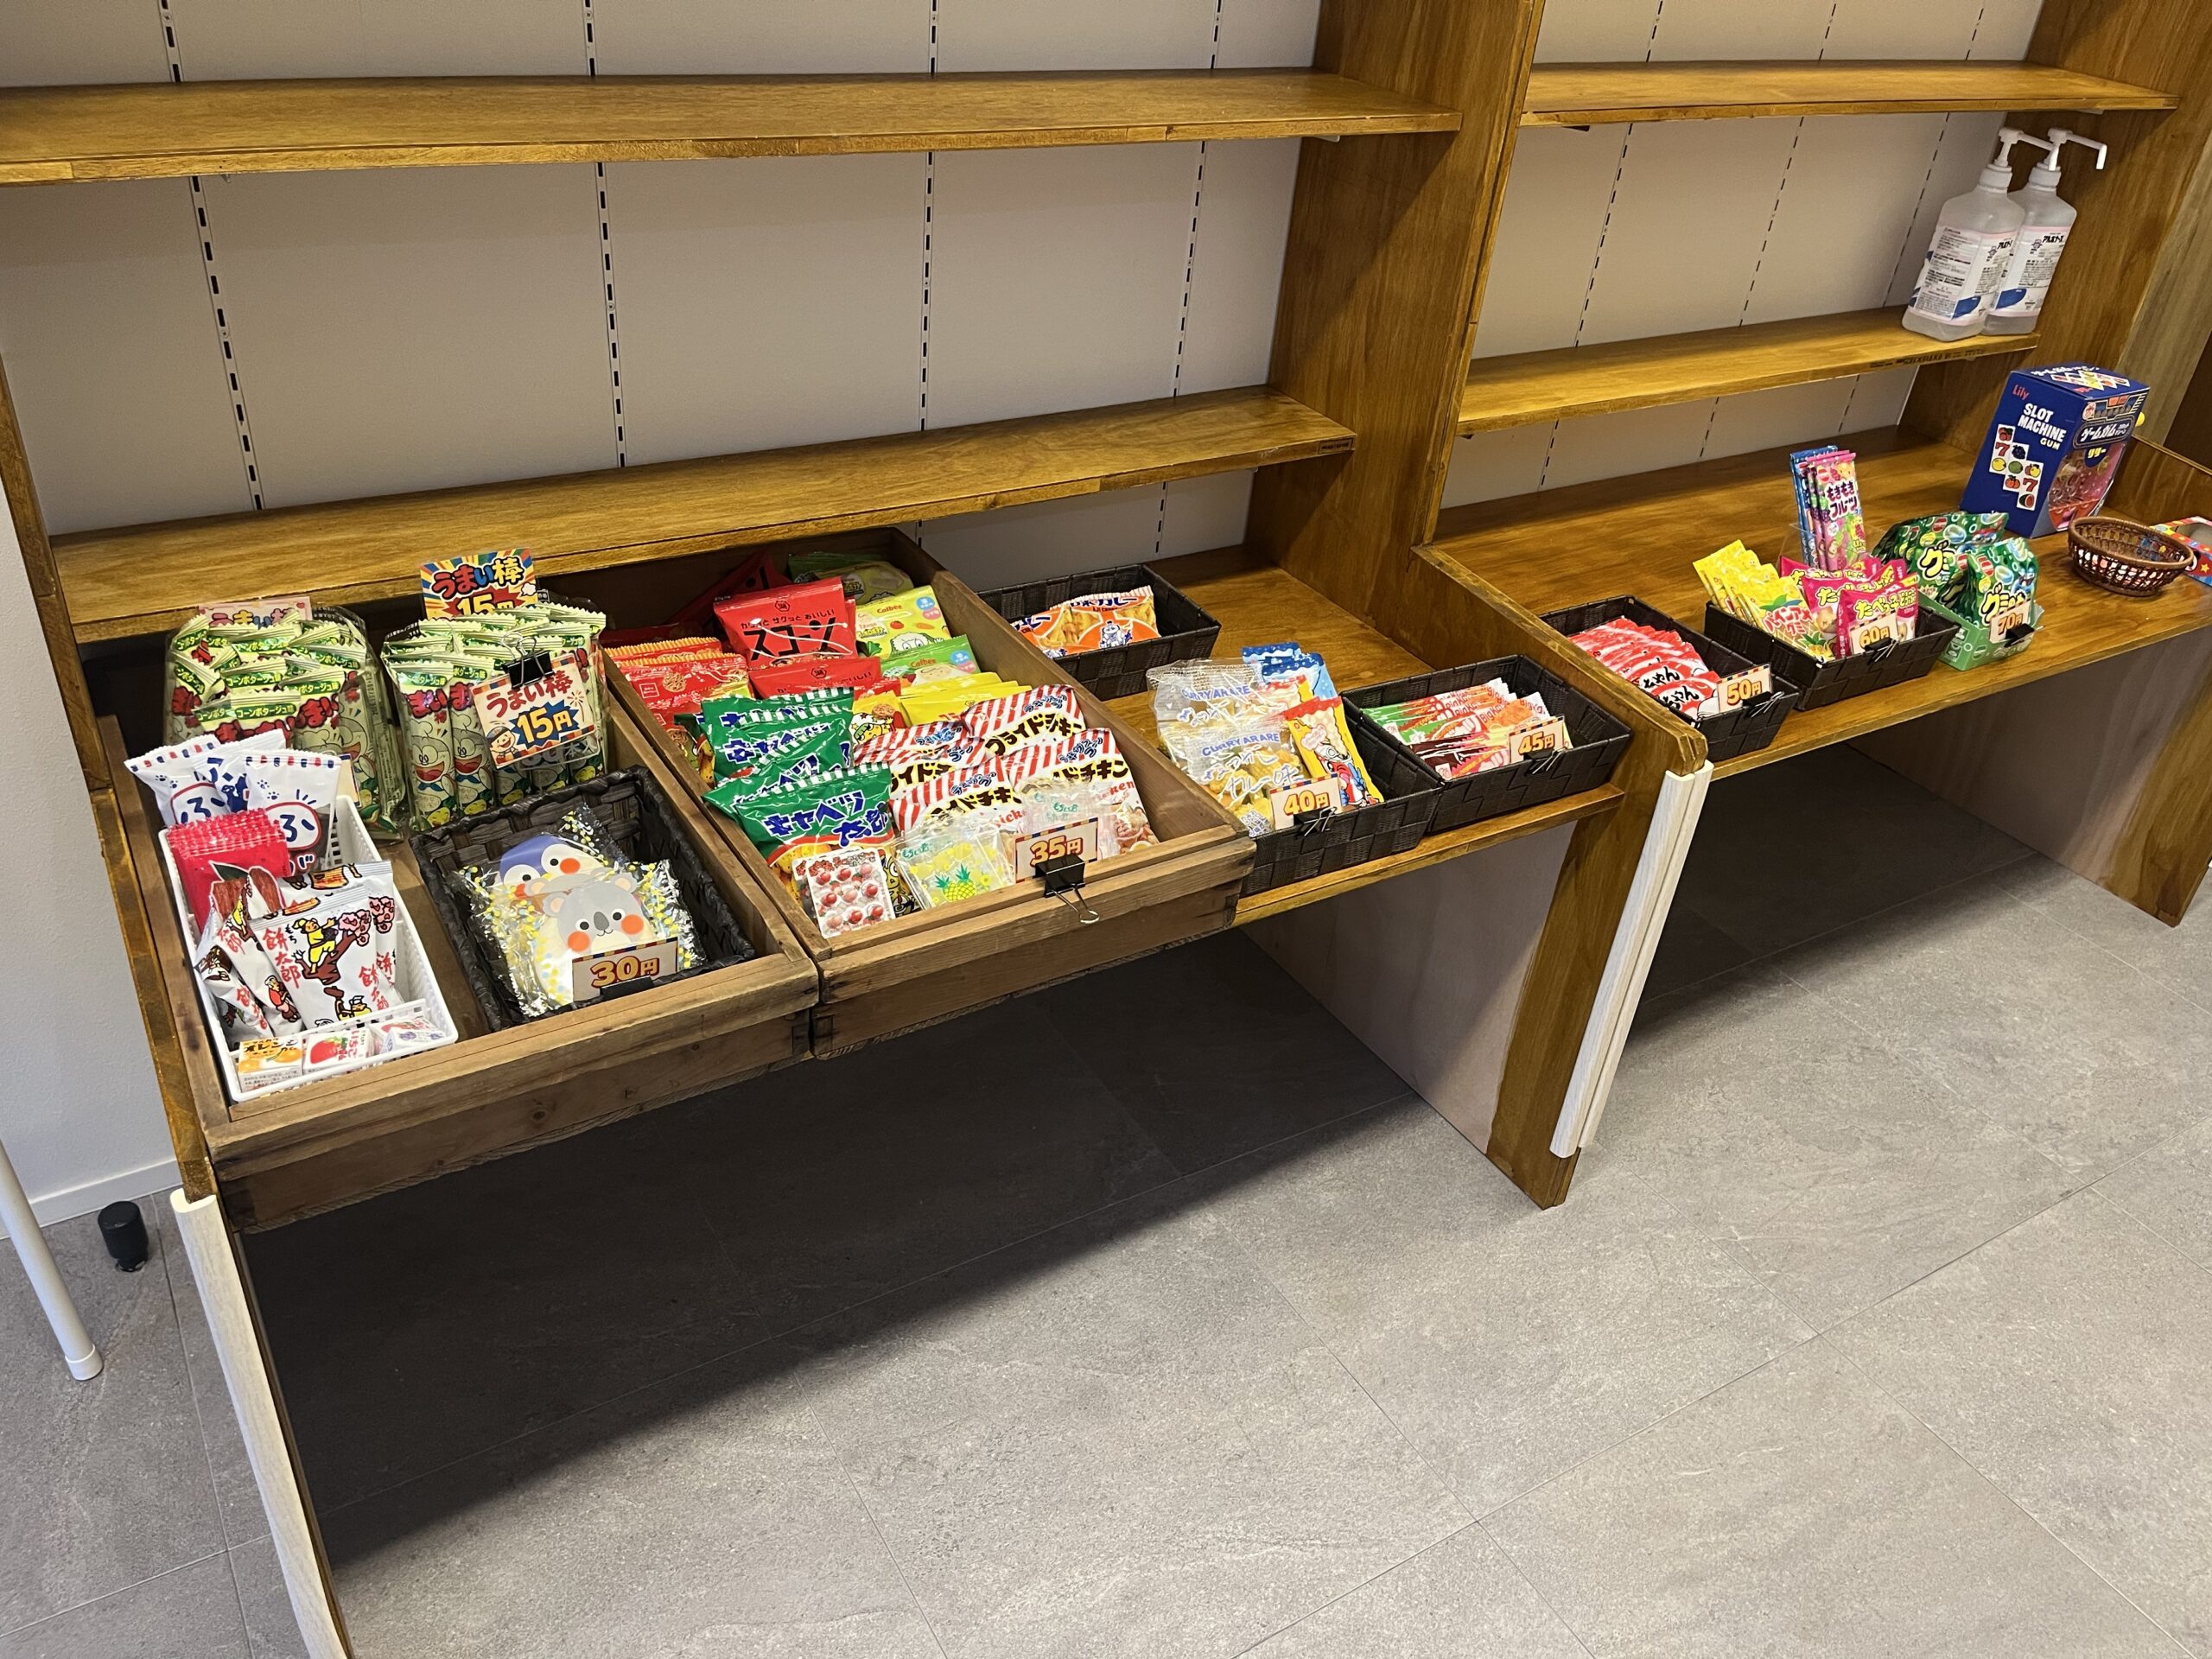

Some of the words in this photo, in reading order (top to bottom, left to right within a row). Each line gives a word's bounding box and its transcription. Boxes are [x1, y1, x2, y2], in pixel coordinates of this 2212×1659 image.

[2012, 384, 2030, 400] Lily
[2023, 403, 2054, 422] SLOT
[2017, 414, 2068, 442] MACHINE
[2039, 437, 2061, 450] GUM
[432, 556, 524, 599] うまい棒
[804, 609, 836, 620] おいしい
[876, 604, 904, 614] Calbee
[1762, 606, 1813, 632] パインアメ
[1855, 594, 1901, 620] たべっ子
[1786, 620, 1808, 636] グミ
[1997, 613, 2024, 636] 70円
[743, 617, 842, 661] スコーン
[1859, 626, 1891, 650] 60円
[910, 658, 938, 669] Calbee
[486, 671, 574, 719] うまい棒
[1726, 679, 1763, 707] 50円
[516, 707, 573, 744] 15円
[1202, 737, 1242, 757] CURRY
[1243, 733, 1281, 744] ARARE
[1517, 731, 1555, 755] 45円
[764, 790, 865, 838] キャベツ
[1282, 790, 1331, 817] 40円
[832, 802, 890, 847] 太郎
[1029, 835, 1084, 868] 35円
[589, 955, 660, 989] 30円
